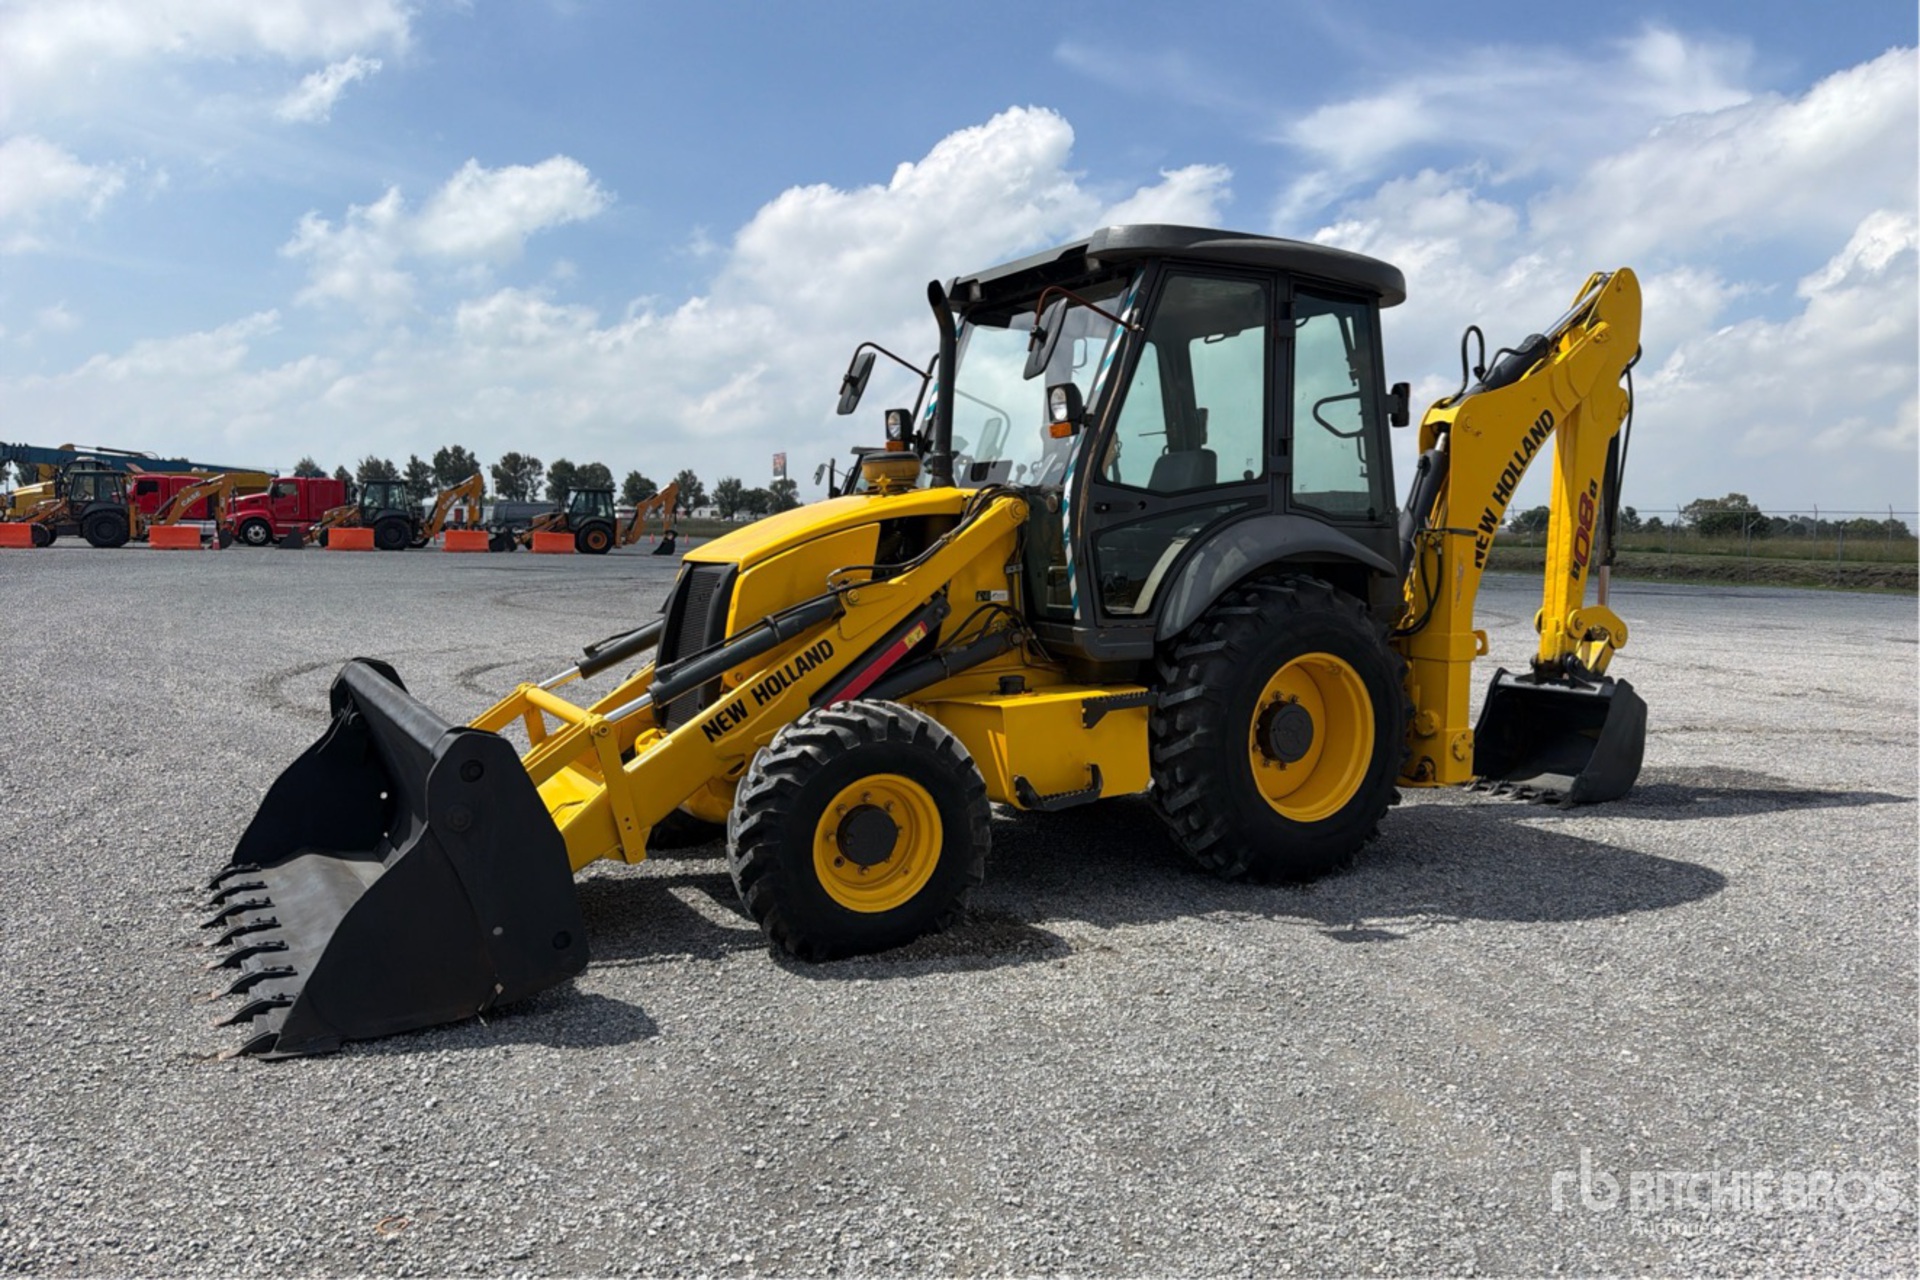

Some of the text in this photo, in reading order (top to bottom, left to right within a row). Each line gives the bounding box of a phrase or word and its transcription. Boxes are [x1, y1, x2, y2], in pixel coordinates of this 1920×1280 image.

[1474, 408, 1555, 569] NEW HOLLAND
[701, 638, 835, 743] NEW HOLLAND
